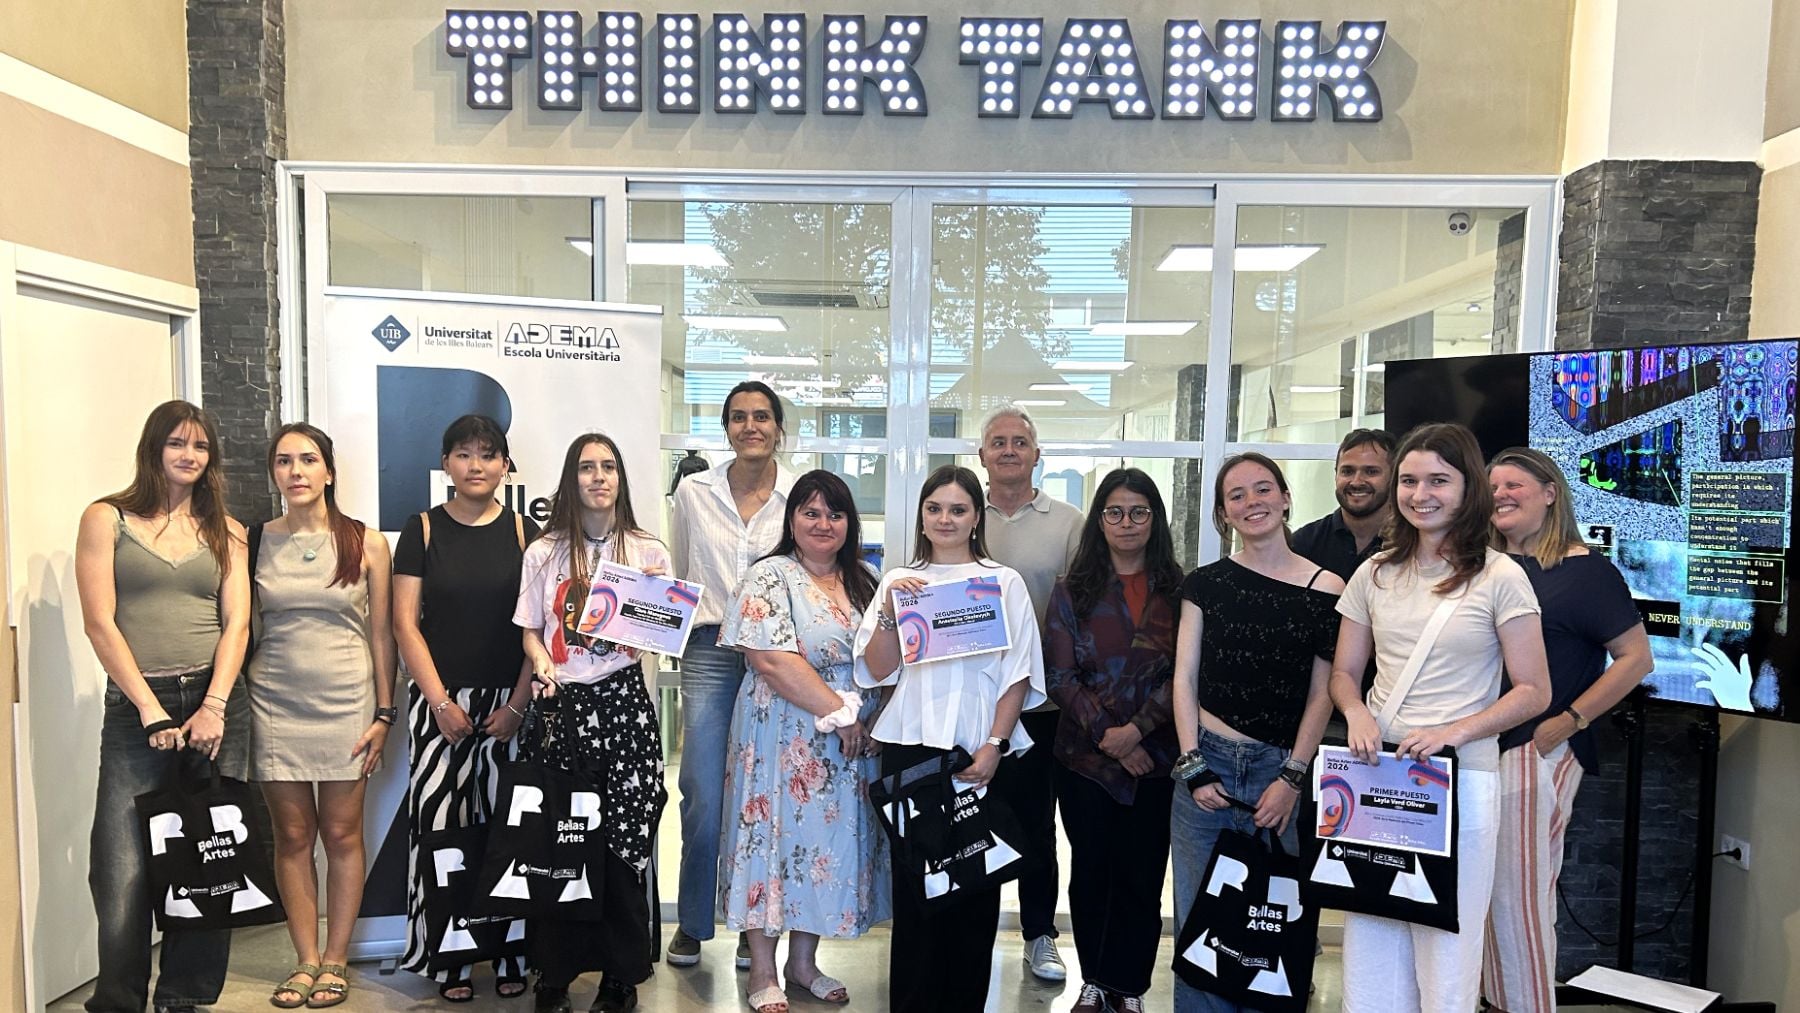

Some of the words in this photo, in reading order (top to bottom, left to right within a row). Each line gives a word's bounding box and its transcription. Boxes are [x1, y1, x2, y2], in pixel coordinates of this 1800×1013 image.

[445, 9, 928, 116] THINK
[959, 16, 1386, 122] TANK
[380, 328, 401, 340] UIB
[425, 326, 492, 340] Universitat
[504, 322, 620, 349] ADEMA
[504, 346, 542, 358] Escola
[546, 348, 620, 362] Universitària
[1718, 567, 1744, 575] between
[602, 574, 620, 584] 2026
[628, 598, 658, 610] SEGUNDO
[659, 606, 682, 616] PUESTO
[901, 599, 918, 607] 2026
[934, 608, 966, 618] SEGUNDO
[966, 604, 991, 612] PUESTO
[1648, 612, 1680, 624] NEVER
[1686, 616, 1752, 631] UNDERSTAND
[1327, 762, 1349, 771] 2026
[1370, 787, 1398, 796] PRIMER
[1400, 790, 1430, 800] PUESTO
[197, 835, 232, 853] Bellas
[557, 833, 584, 844] Artes
[203, 847, 236, 864] Artes
[1248, 904, 1283, 920] Bellas
[1246, 918, 1282, 933] Artes
